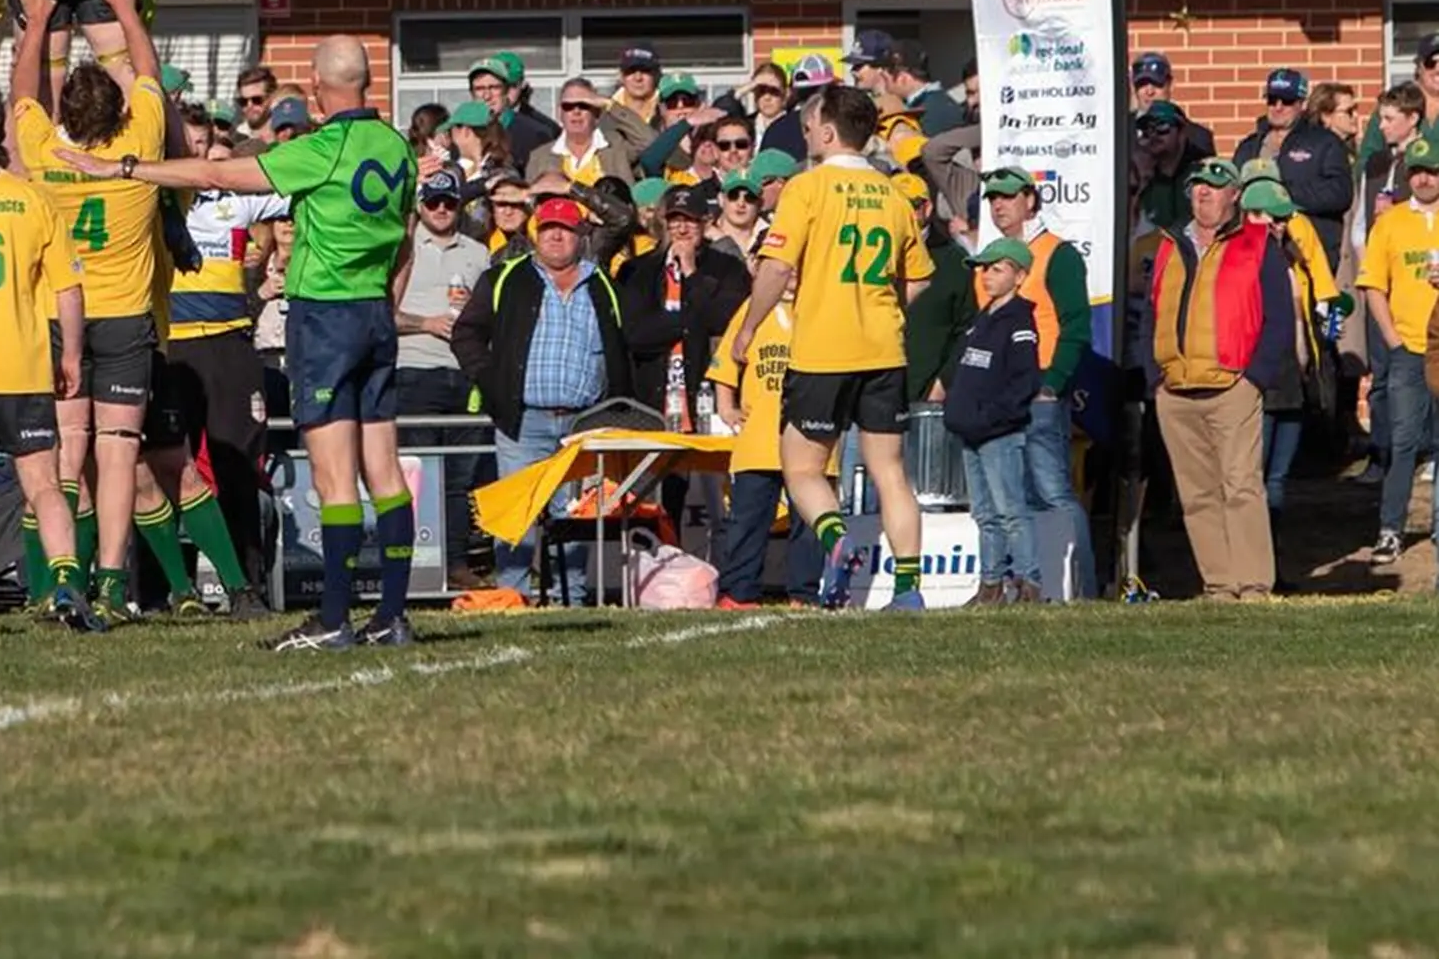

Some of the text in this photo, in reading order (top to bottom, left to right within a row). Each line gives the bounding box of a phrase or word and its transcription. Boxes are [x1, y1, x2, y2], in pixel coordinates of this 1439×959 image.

[1018, 85, 1095, 100] NEW HOLLAND
[1071, 112, 1098, 129] Ag
[73, 194, 109, 251] 4
[839, 223, 893, 286] 22
